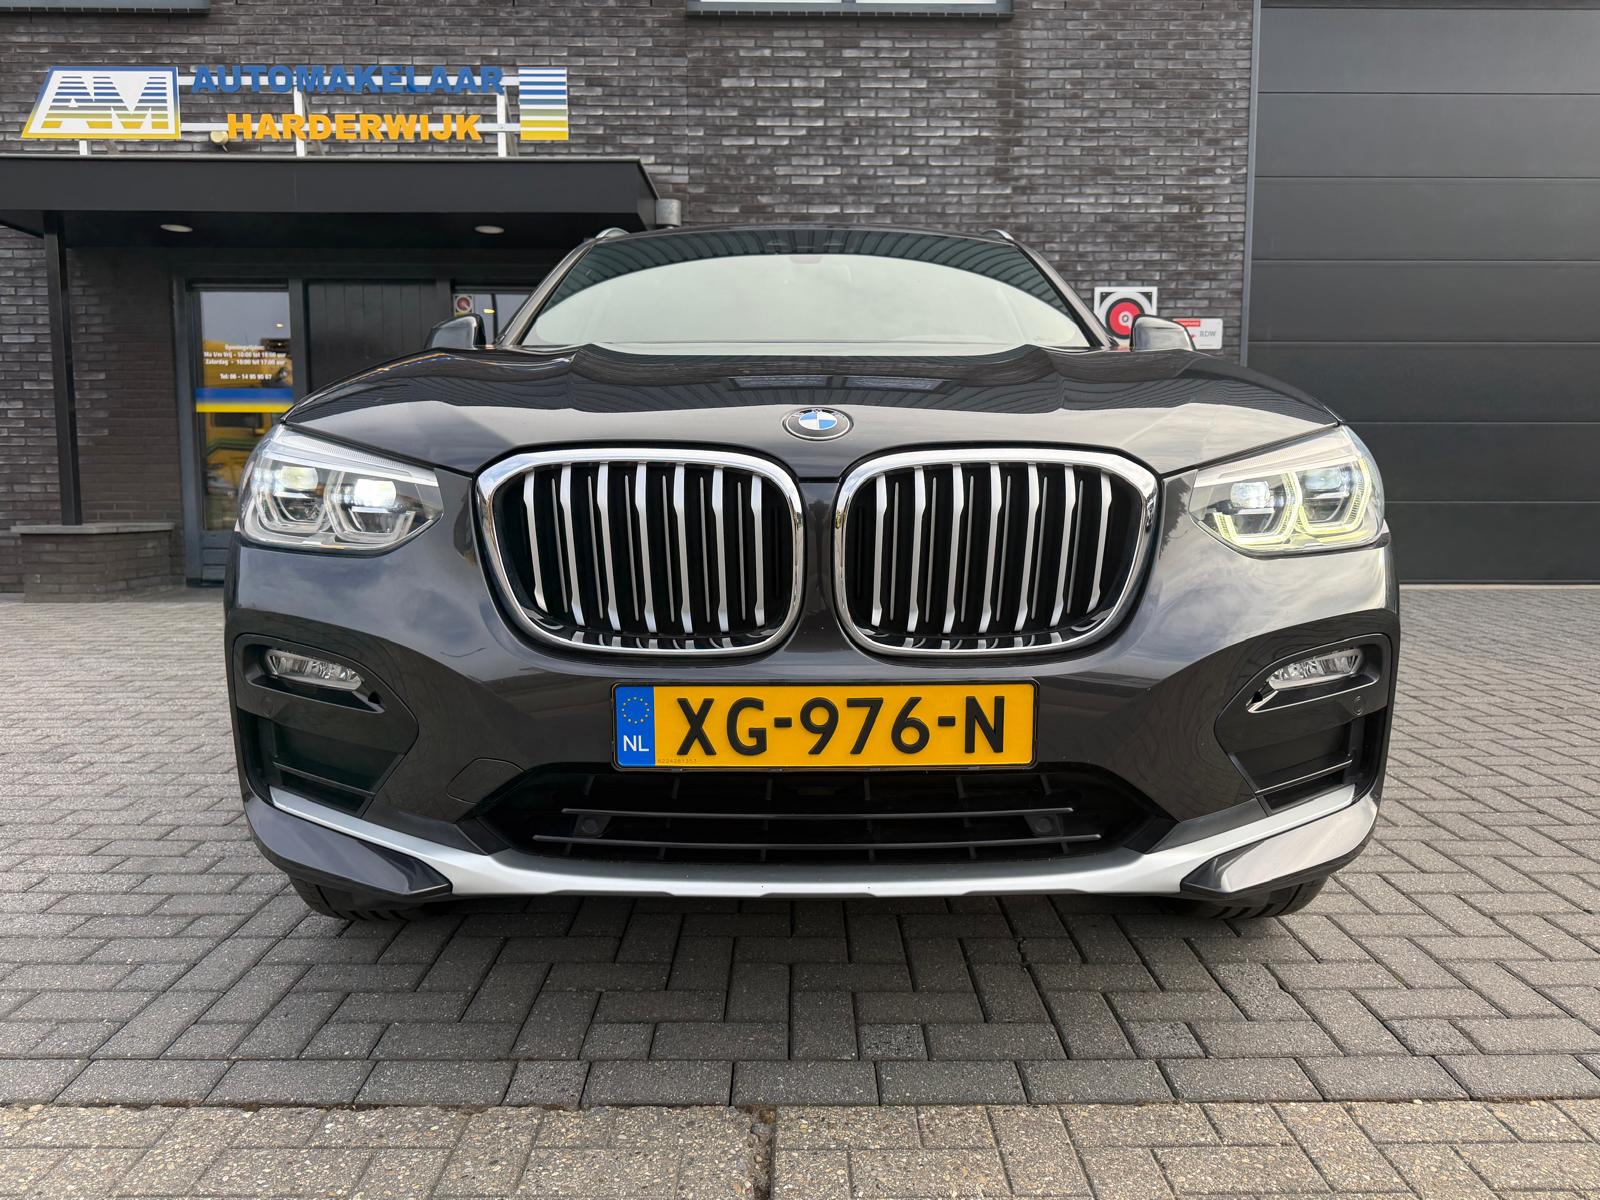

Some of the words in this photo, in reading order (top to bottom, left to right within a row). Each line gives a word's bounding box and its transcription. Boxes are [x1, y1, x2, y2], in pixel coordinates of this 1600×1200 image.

[191, 65, 504, 94] AUTOMAKELAAR
[227, 113, 483, 141] HARDERWIJK
[676, 696, 1005, 756] XG-976-N
[623, 735, 650, 752] NL
